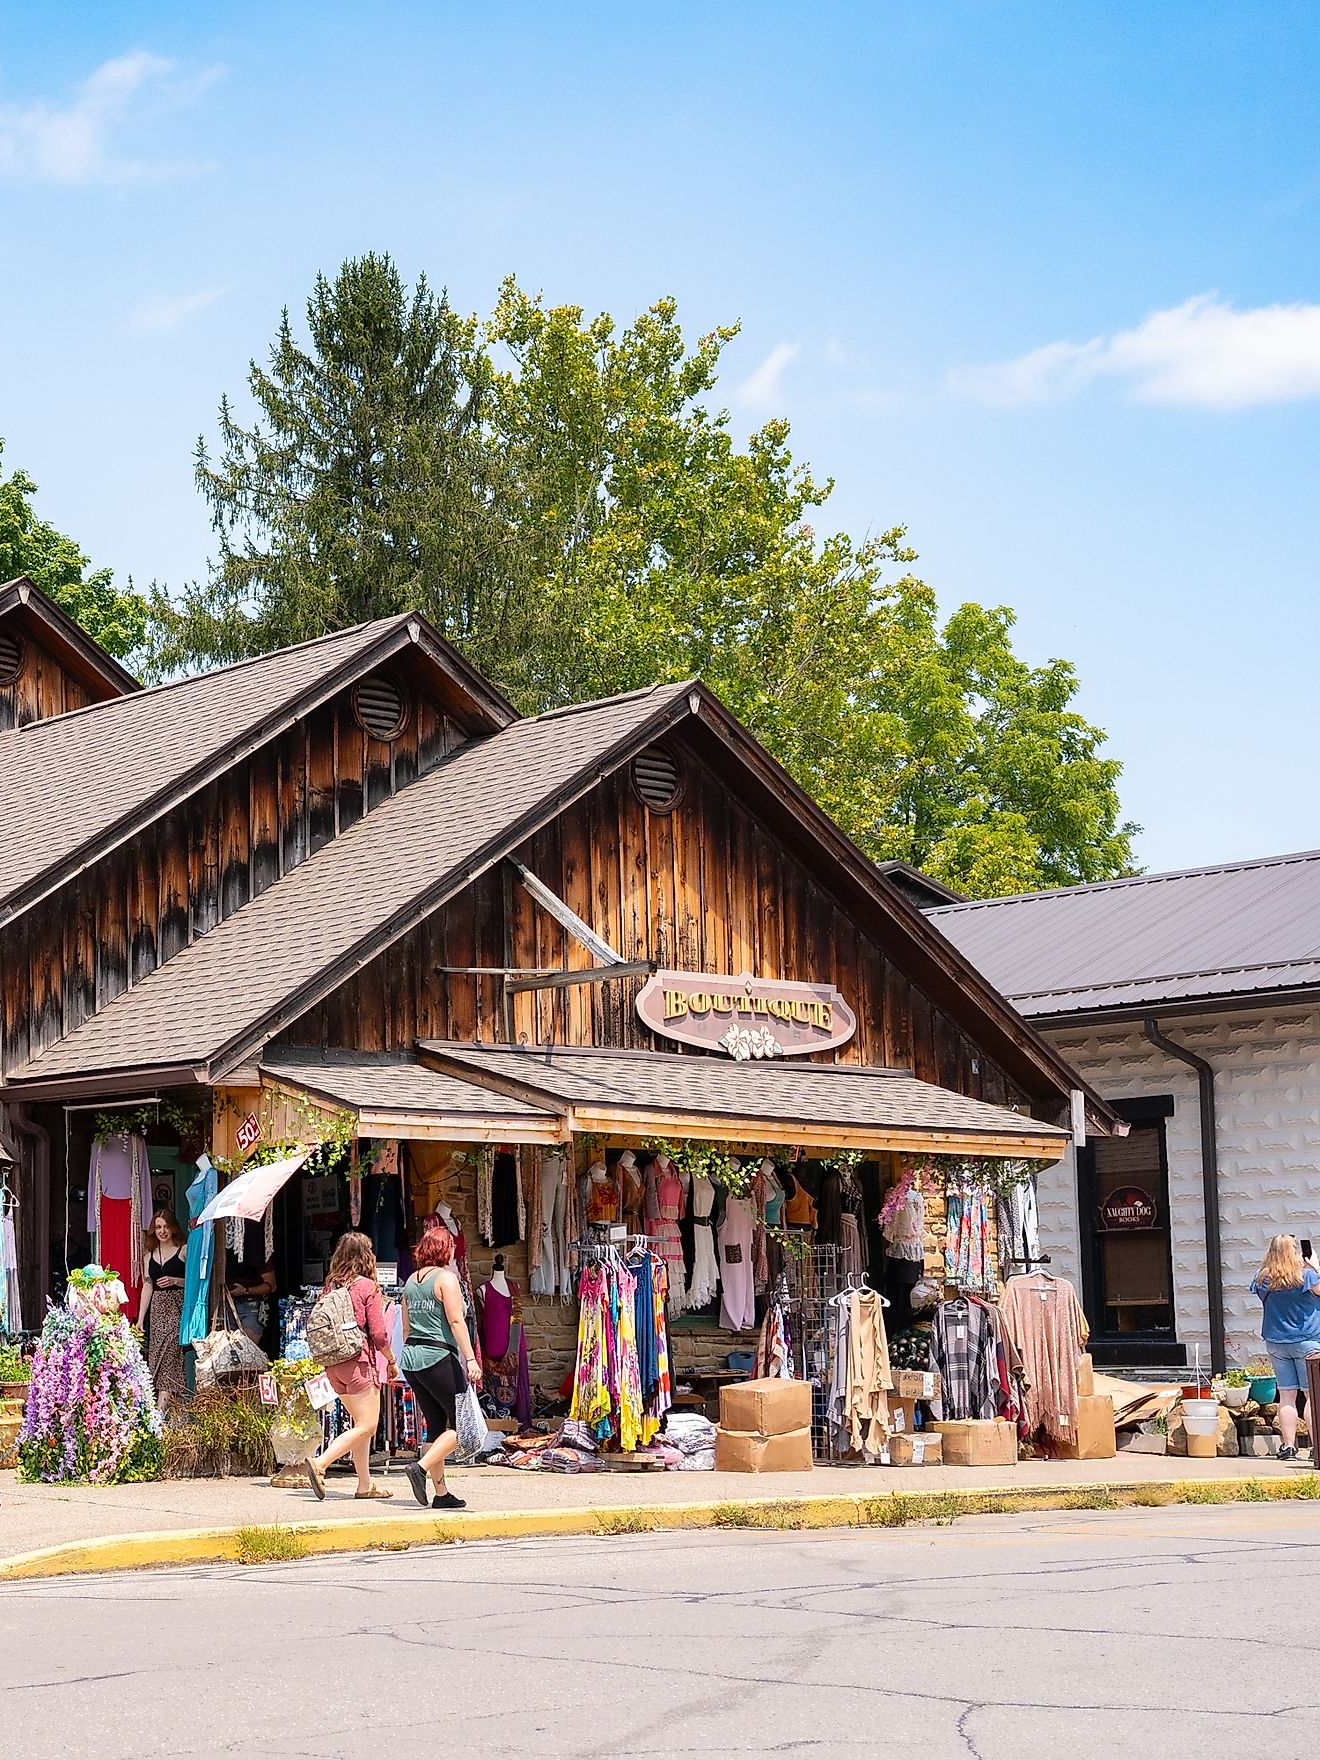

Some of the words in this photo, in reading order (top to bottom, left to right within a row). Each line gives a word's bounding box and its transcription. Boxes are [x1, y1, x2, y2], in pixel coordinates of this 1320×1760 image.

[663, 989, 834, 1032] BOUTIQUE
[238, 1122, 255, 1149] 50
[1136, 1206, 1152, 1216] DOG
